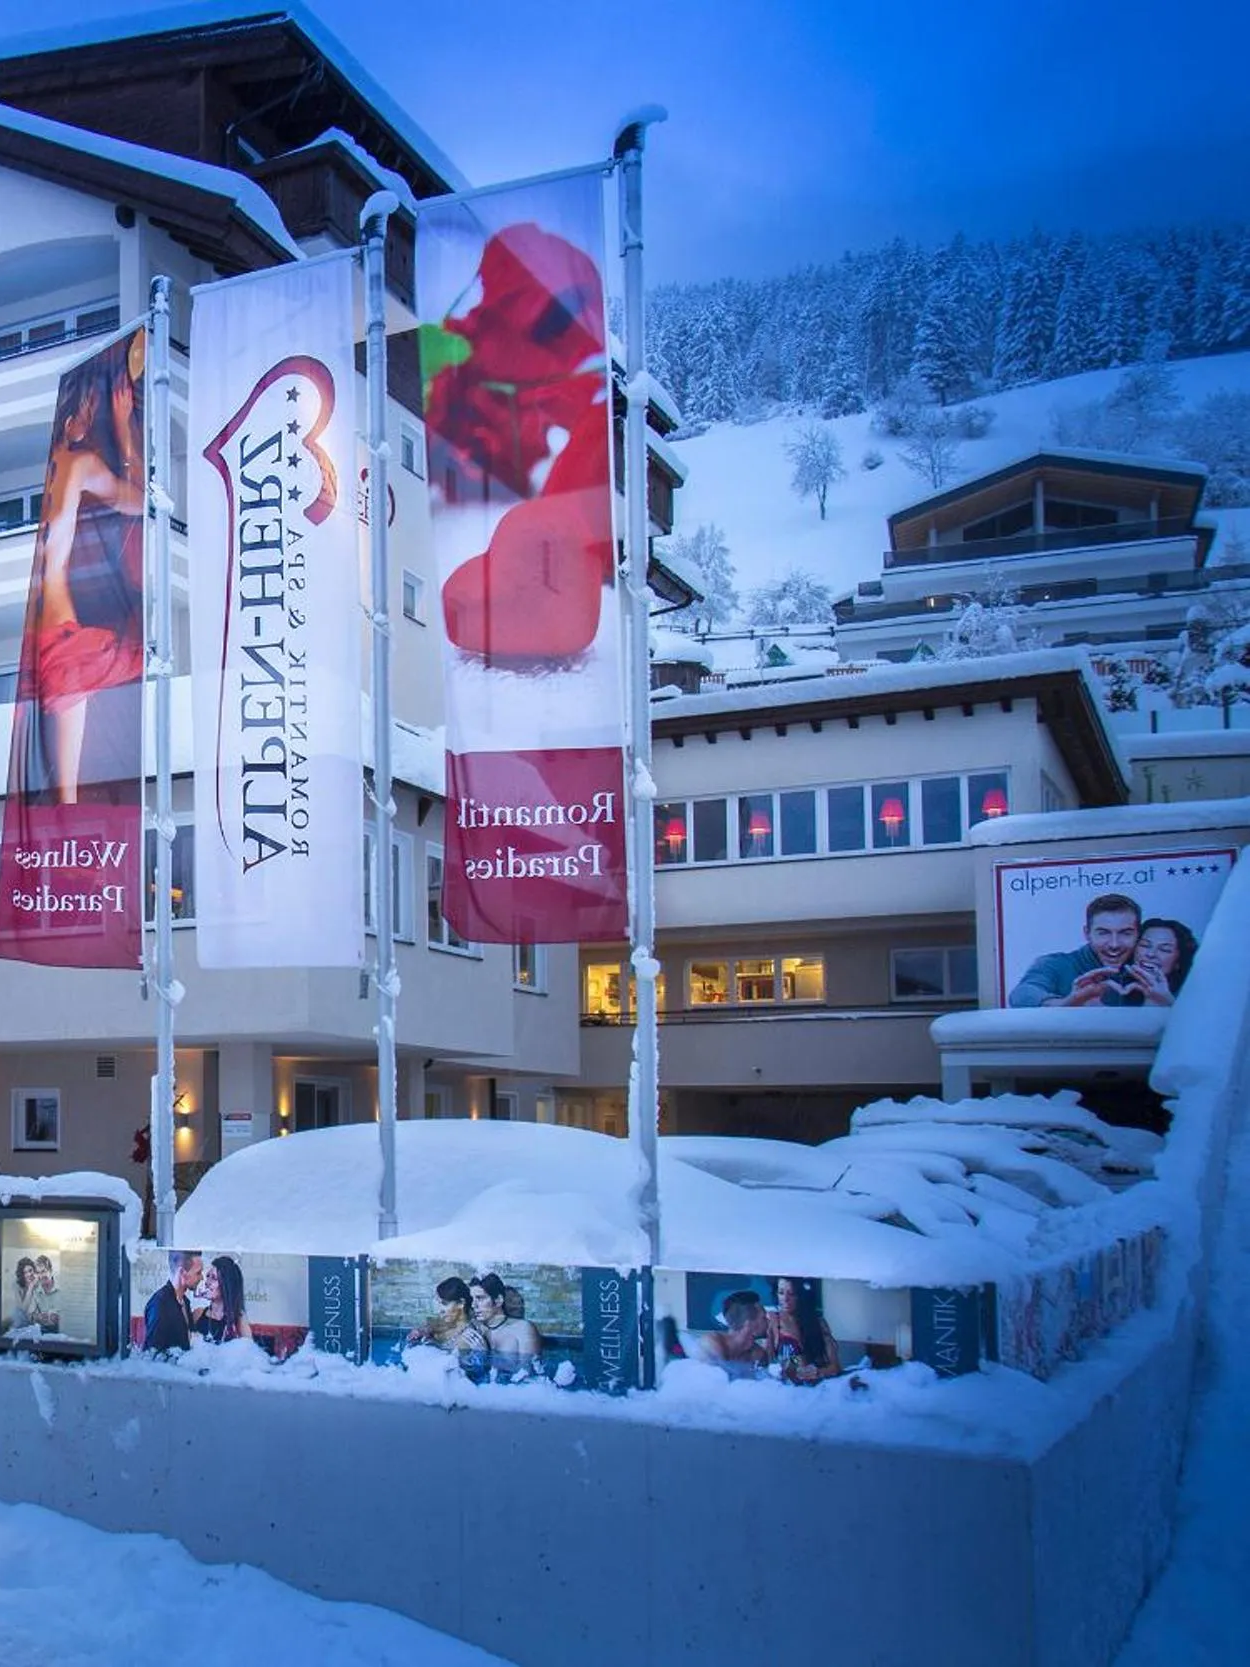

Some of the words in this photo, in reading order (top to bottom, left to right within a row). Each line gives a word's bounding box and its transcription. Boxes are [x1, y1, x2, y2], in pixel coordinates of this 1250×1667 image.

[1010, 865, 1155, 896] alpen-herz.at
[323, 1274, 343, 1354] GENUSS
[598, 1279, 622, 1389] WELLNESS
